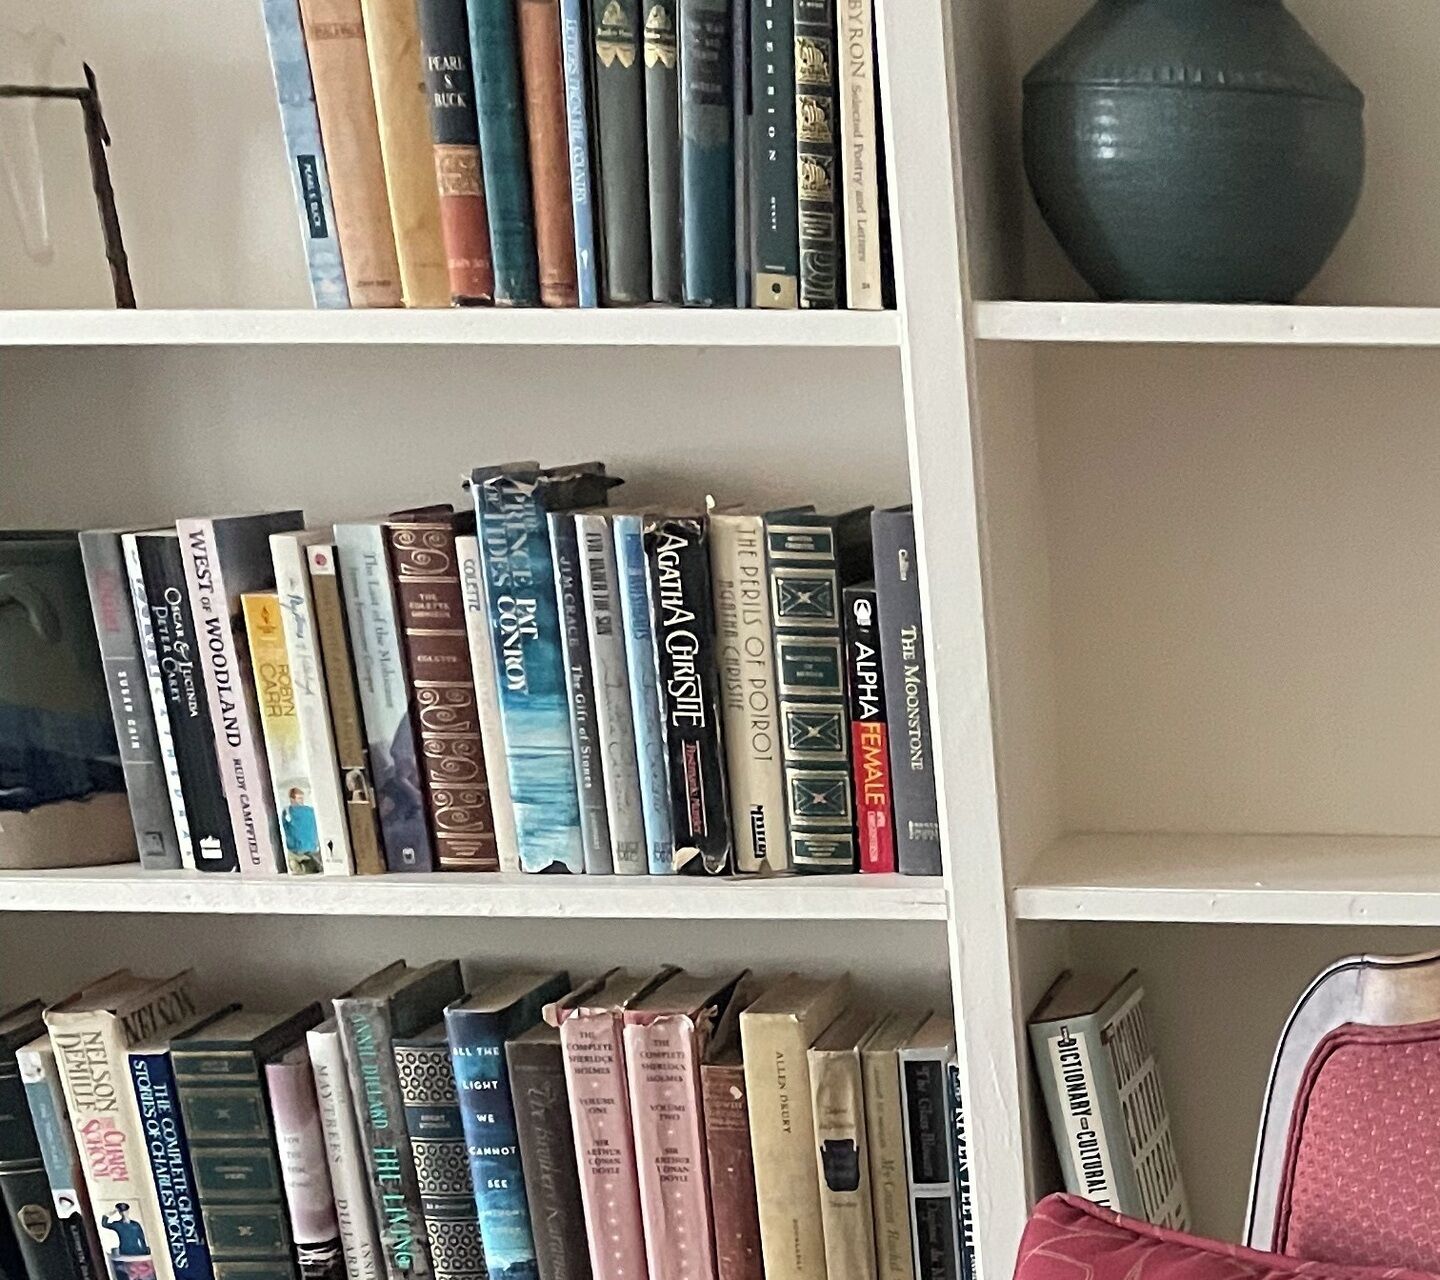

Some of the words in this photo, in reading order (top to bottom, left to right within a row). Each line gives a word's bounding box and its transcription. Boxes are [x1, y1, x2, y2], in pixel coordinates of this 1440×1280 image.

[849, 0, 866, 79] BYRON
[428, 55, 465, 71] PEARL
[444, 74, 453, 89] S
[433, 93, 467, 108] BUCK
[851, 84, 867, 138] Selected
[853, 143, 868, 187] Poetry
[855, 190, 867, 214] and
[857, 219, 869, 263] Letters
[187, 529, 215, 594] WEST
[736, 528, 757, 558] THE
[463, 558, 482, 612] COLETTE
[560, 555, 575, 588] JIM
[656, 531, 696, 627] AGATHA
[200, 596, 213, 613] OF
[718, 579, 739, 639] AGATHA
[739, 566, 764, 628] PERILS
[152, 605, 172, 653] PETER
[515, 598, 539, 640] PAT
[563, 591, 581, 647] CRACE
[164, 587, 186, 638] OSCAR
[178, 661, 200, 718] LUCINDA
[496, 595, 529, 697] CONROY
[744, 636, 766, 667] OF
[901, 625, 918, 660] THE
[204, 617, 242, 748] WOODLAND
[259, 663, 282, 717] CARR
[278, 664, 296, 717] ROBYN
[571, 665, 584, 691] The
[665, 628, 707, 729] CHRISTIE
[724, 645, 745, 712] CHRISTIE
[854, 641, 880, 720] ALPHA
[574, 694, 589, 722] Gift
[748, 677, 774, 762] POIROT
[904, 666, 924, 771] MOONSTONE
[580, 746, 592, 789] Stones
[860, 722, 887, 806] FEMALE
[240, 793, 262, 866] CAMPFIELD
[351, 1014, 377, 1057] ANNIE
[452, 1046, 472, 1057] ALL
[476, 1046, 500, 1056] THE
[566, 1042, 613, 1051] COMPLETE
[640, 1051, 686, 1060] COMPLETE
[653, 1039, 670, 1048] THE
[54, 1031, 92, 1113] DEMILLE
[82, 1030, 119, 1113] NELSON
[568, 1055, 614, 1064] SHERLOCK
[574, 1066, 612, 1075] HOLMES
[640, 1062, 687, 1071] SHERLOCK
[646, 1074, 684, 1083] HOLMES
[775, 1050, 788, 1091] ALLEN
[133, 1059, 157, 1118] STORIES
[153, 1082, 172, 1113] THE
[361, 1065, 389, 1130] DILLARD
[462, 1079, 499, 1091] LIGHT
[579, 1097, 615, 1105] VOLUME
[314, 1062, 343, 1165] MAYTREES
[476, 1113, 496, 1124] WE
[649, 1104, 686, 1113] VOLUME
[659, 1113, 681, 1122] TWO
[779, 1093, 792, 1135] DRURY
[1057, 1038, 1093, 1117] DICTIONARY
[1076, 1130, 1108, 1194] CULTURAL
[145, 1120, 162, 1140] OF
[468, 1145, 518, 1157] CANNOT
[161, 1117, 187, 1195] COMPLETE
[373, 1147, 402, 1186] THE
[587, 1148, 622, 1156] ARTHUR
[588, 1158, 622, 1166] CONAN
[591, 1166, 621, 1175] DOYLE
[655, 1157, 690, 1165] ARTHUR
[150, 1142, 176, 1207] CHARLES
[487, 1179, 509, 1189] SEE
[660, 1174, 689, 1183] DOYLE
[163, 1208, 190, 1269] DICKENS
[176, 1196, 199, 1245] GHOST
[336, 1198, 360, 1280] DILLARD
[382, 1194, 415, 1270] LIVING
